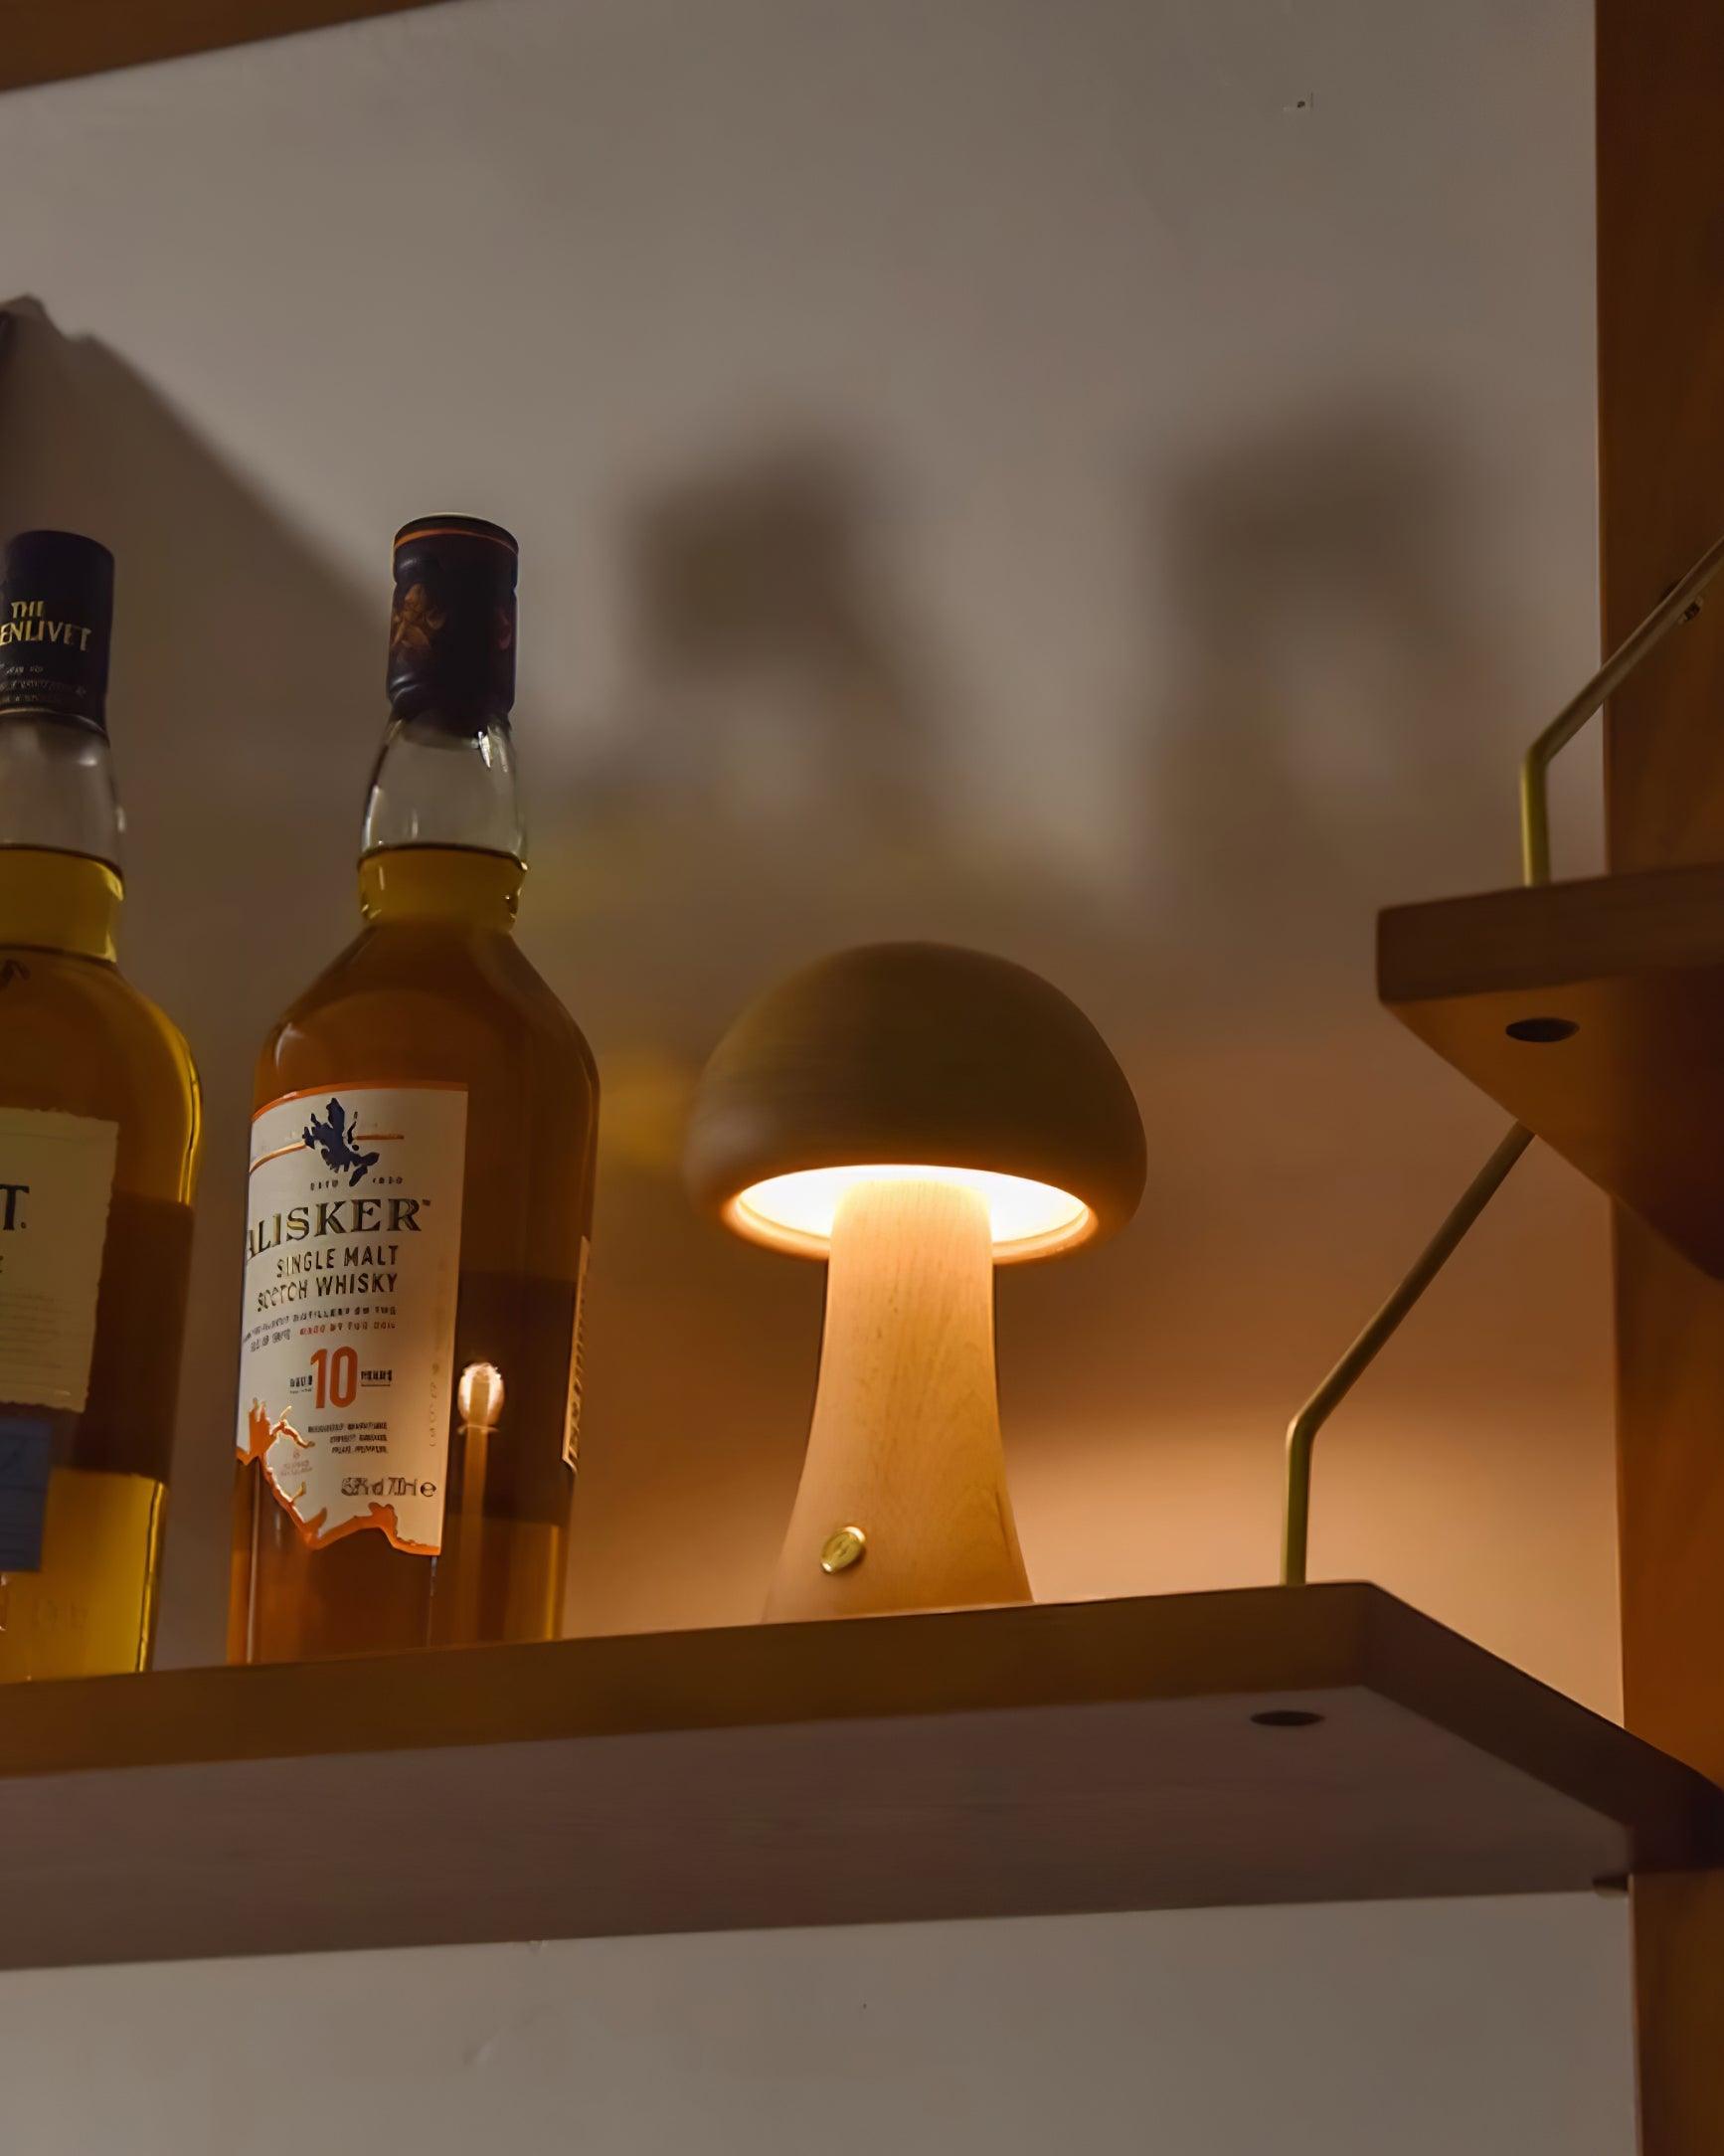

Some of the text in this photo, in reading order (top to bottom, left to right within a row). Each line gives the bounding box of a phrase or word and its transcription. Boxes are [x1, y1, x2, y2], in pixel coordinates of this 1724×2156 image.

[11, 600, 45, 620] THE
[276, 1245, 398, 1278] SINGLE MALT
[257, 1273, 398, 1312] SCOTCH WHISKY
[310, 1346, 359, 1409] 10
